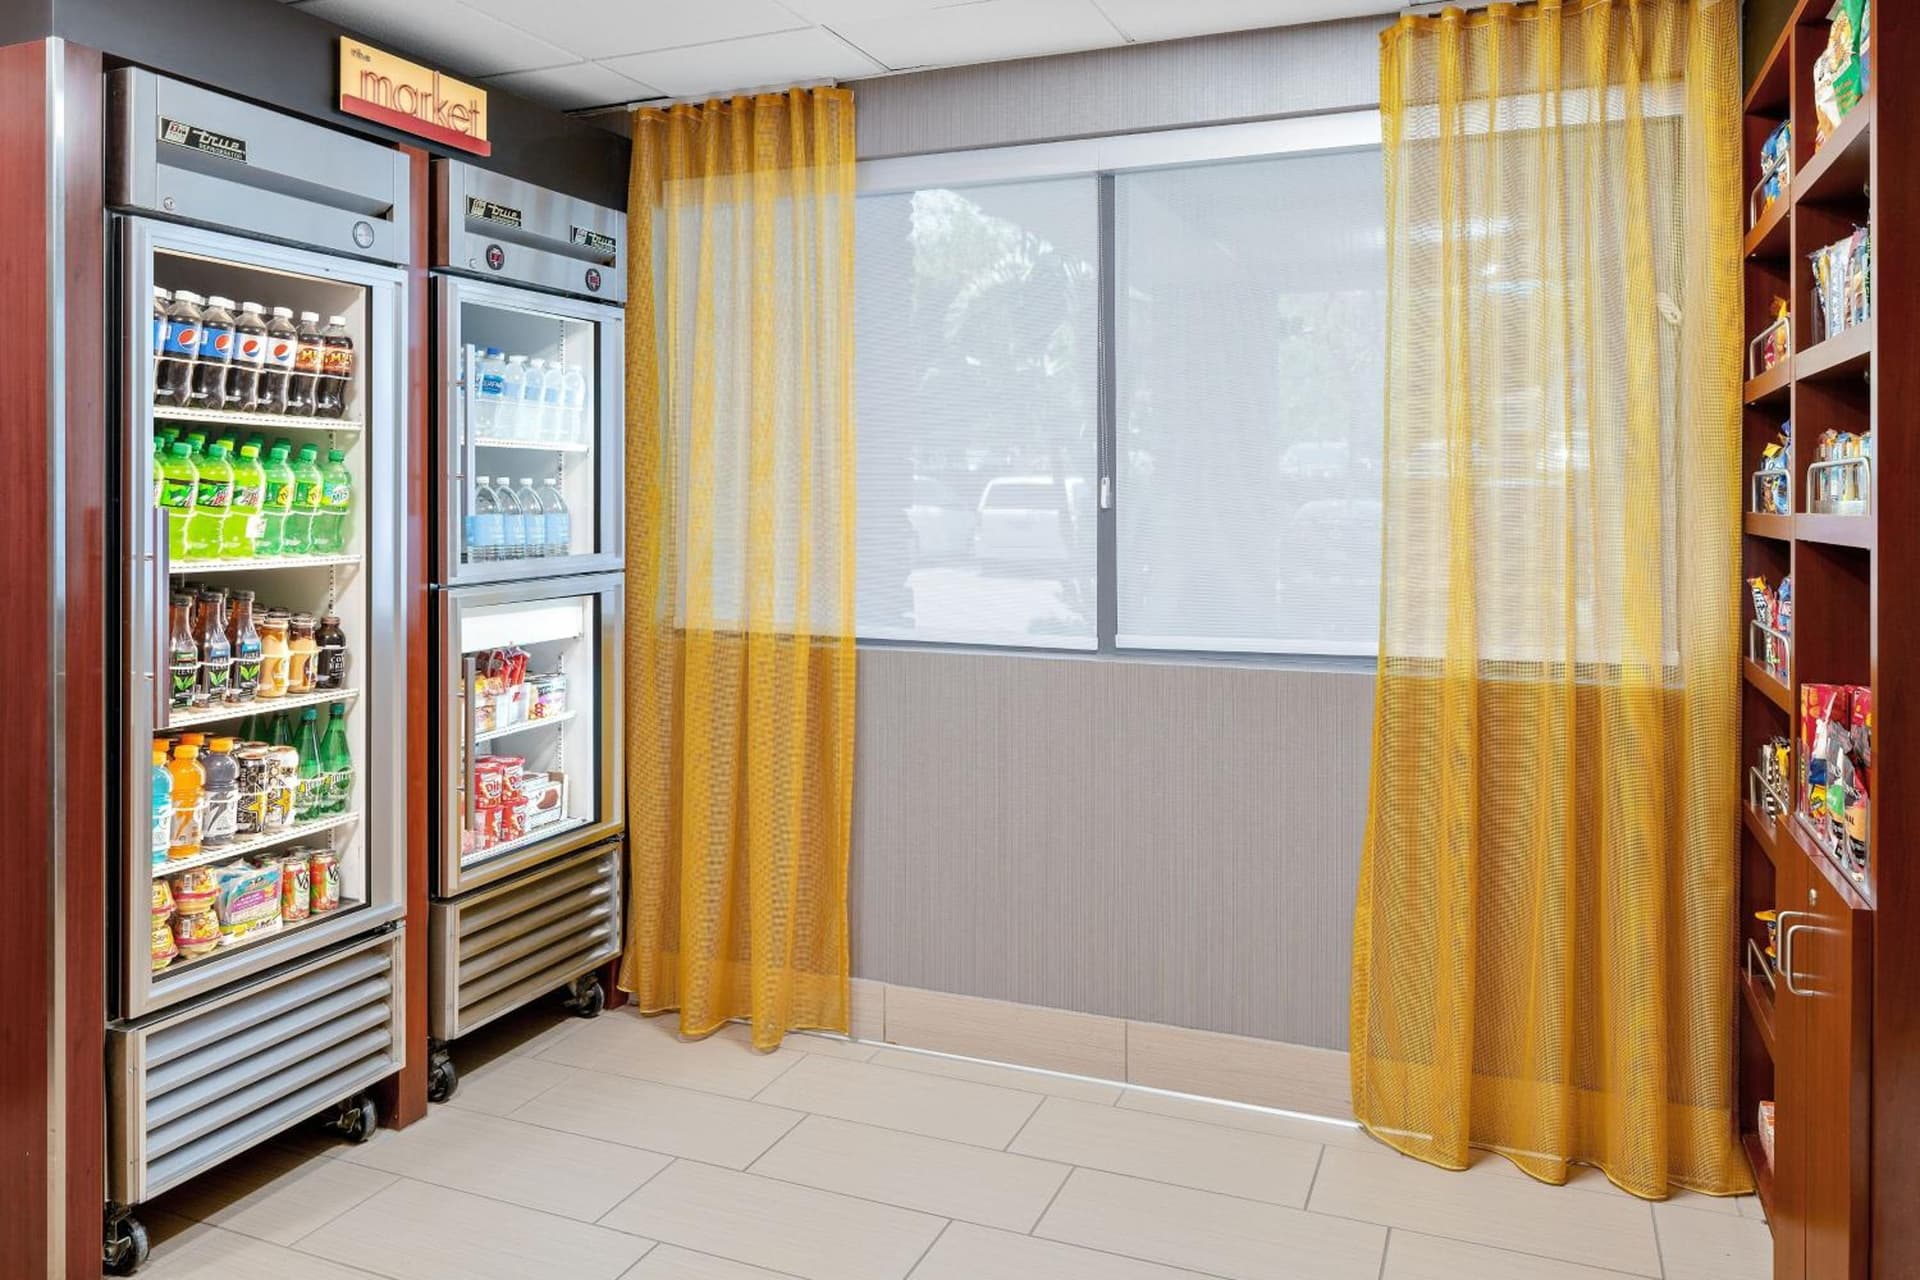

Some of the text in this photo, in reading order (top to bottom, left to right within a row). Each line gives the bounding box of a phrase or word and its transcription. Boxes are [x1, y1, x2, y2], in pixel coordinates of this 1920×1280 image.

[351, 48, 371, 62] the
[360, 70, 480, 137] market
[296, 872, 309, 890] V8
[328, 865, 340, 882] V8
